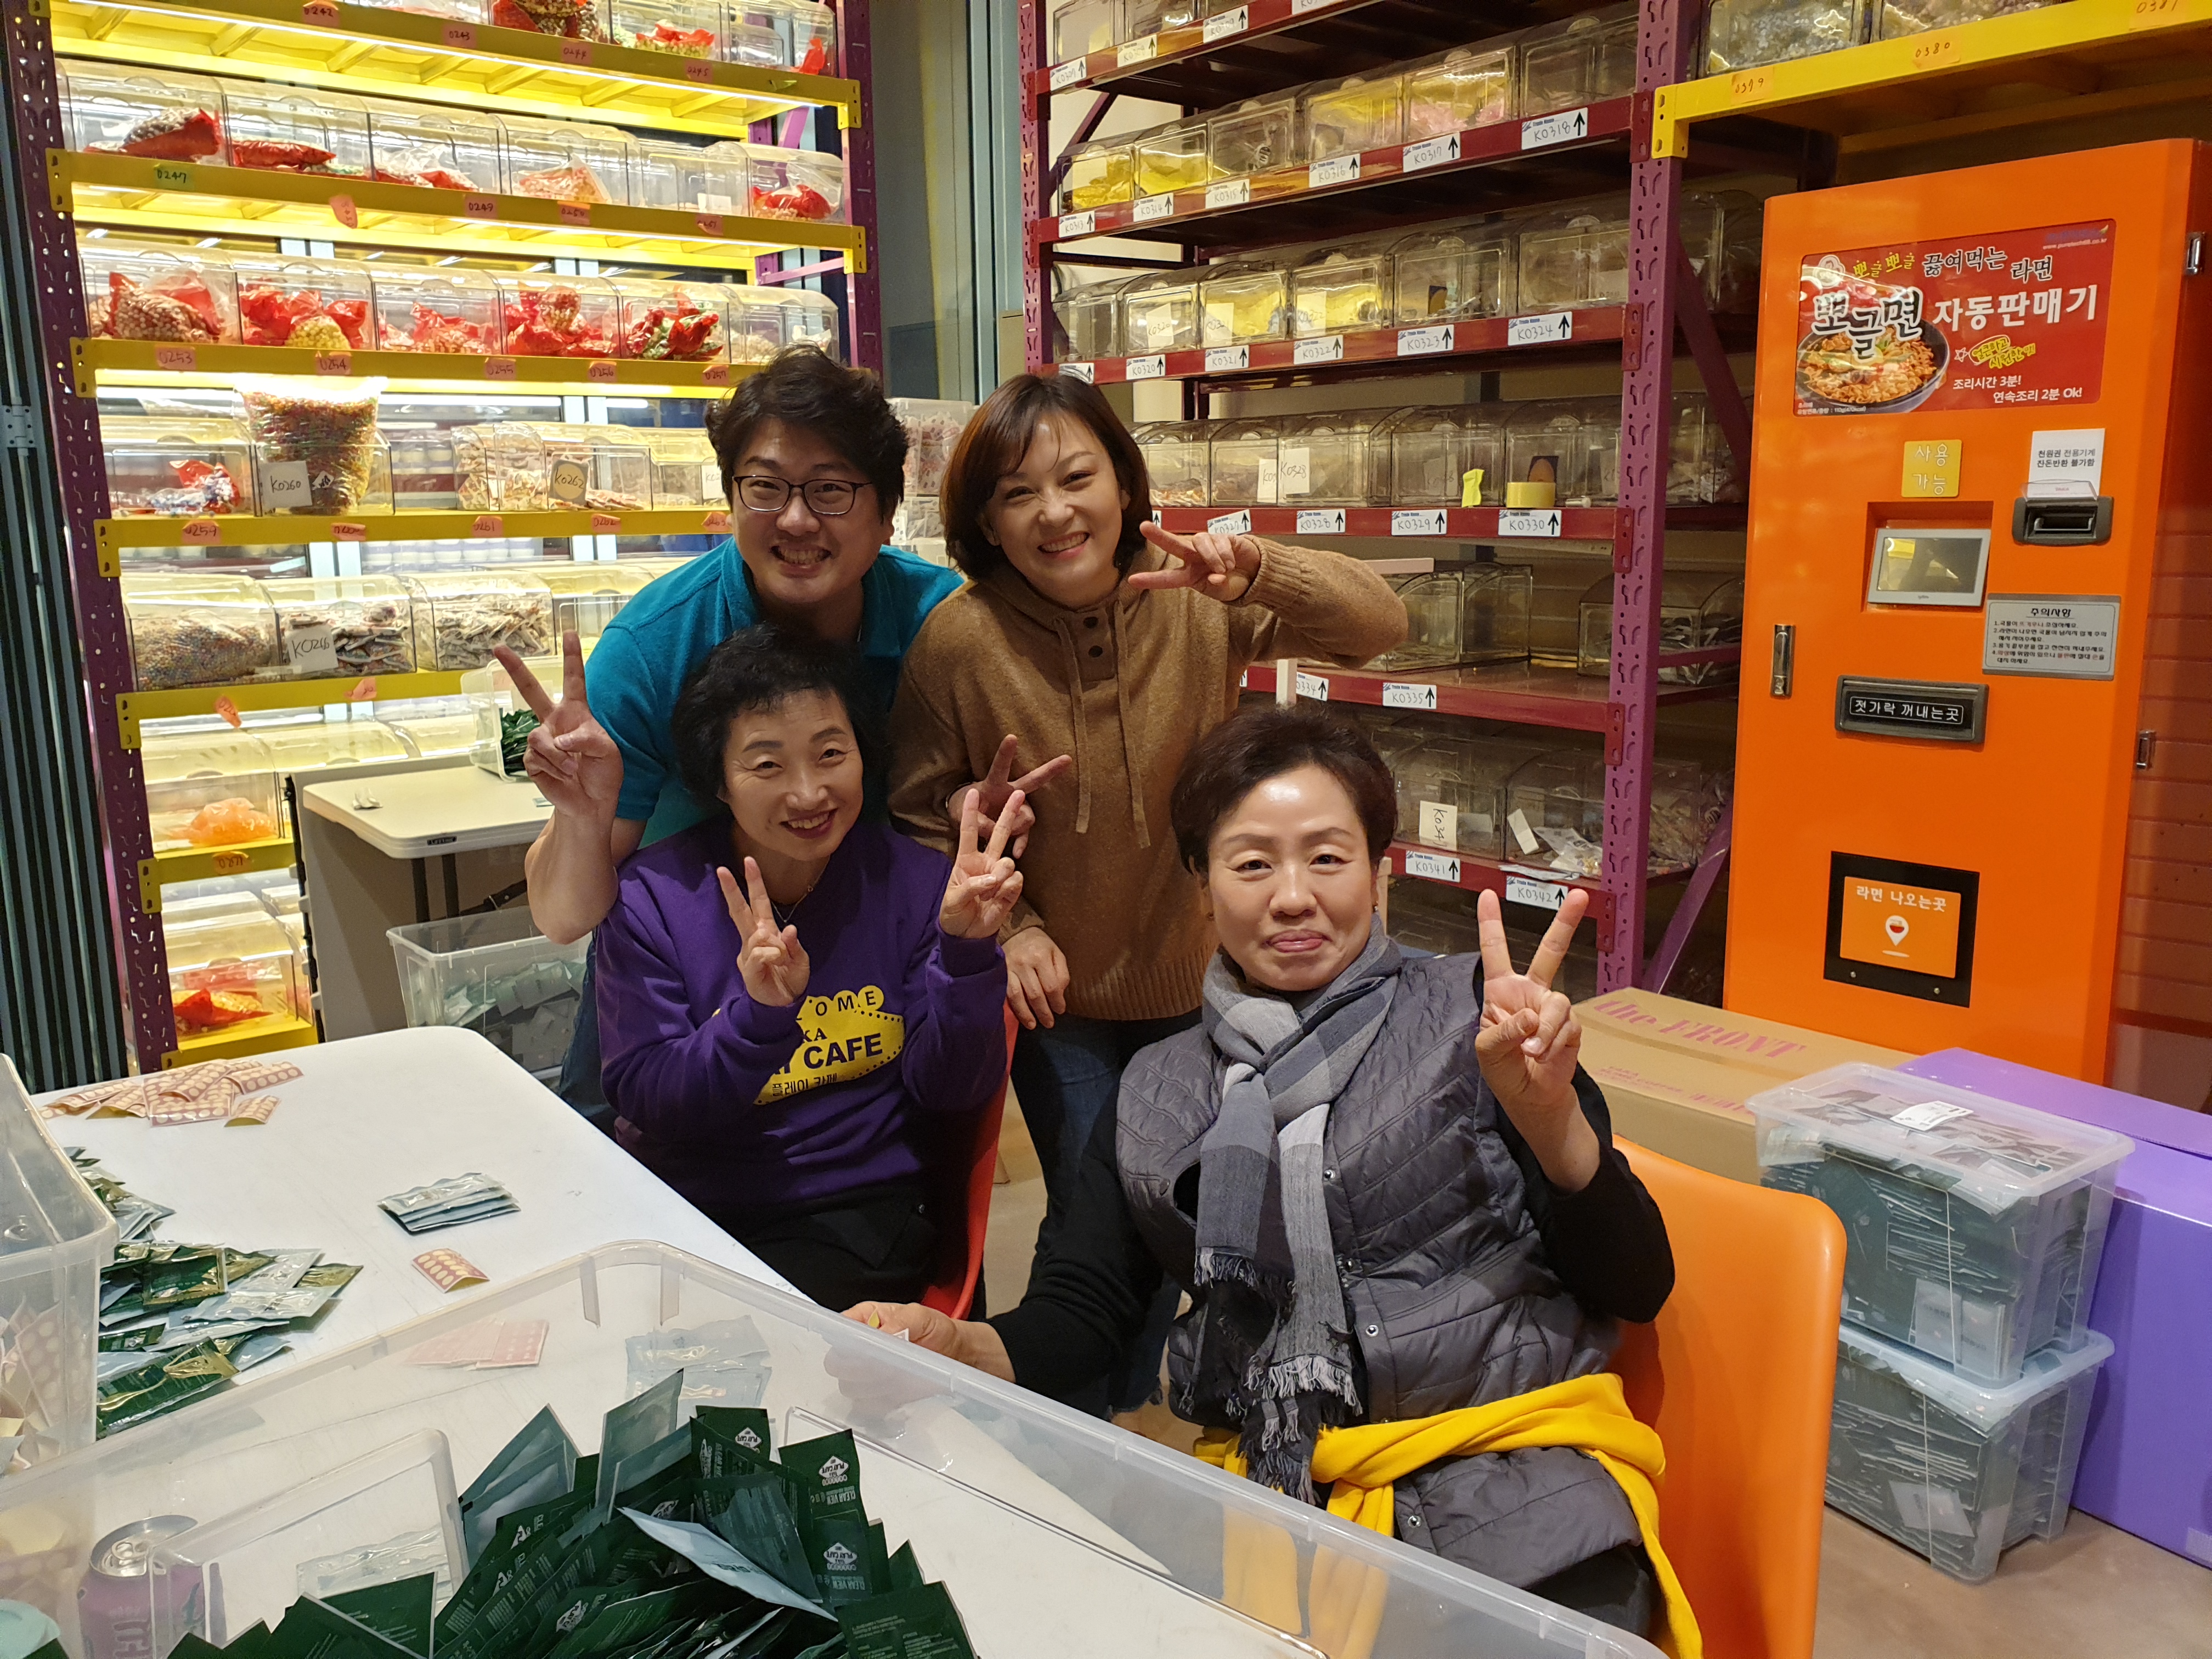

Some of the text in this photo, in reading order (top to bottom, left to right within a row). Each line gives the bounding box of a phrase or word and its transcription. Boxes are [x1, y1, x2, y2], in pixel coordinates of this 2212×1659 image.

[1915, 42, 1950, 58] 0380
[1533, 121, 1571, 142] K0318
[157, 168, 187, 184] 0247
[2010, 255, 2052, 284] 라면
[1933, 285, 2098, 331] 자동판매기
[1517, 324, 1553, 340] K0324
[1408, 336, 1440, 349] K0323
[1213, 353, 1237, 366] K0321
[1303, 346, 1331, 359] K0322
[1132, 364, 1156, 376] K0320
[1953, 375, 2021, 390] 조리시간 3분!
[1993, 387, 2083, 403] 연속조리 2분 Ok!
[1914, 443, 1949, 466] 사용
[270, 475, 302, 494] K0260
[553, 467, 584, 490] K0262
[1912, 473, 1948, 495] 가능
[1301, 518, 1331, 531] K0328
[1397, 518, 1430, 531] K0329
[1509, 519, 1545, 532] K0330
[1296, 680, 1317, 696] 0334
[1392, 692, 1423, 704] K0335
[1855, 699, 1959, 722] 젓가락 꺼내는곳
[1415, 859, 1445, 875] K0341
[1517, 887, 1553, 902] K0342
[1857, 885, 1946, 912] 라면 나오는곳
[803, 1033, 883, 1069] CAFE
[772, 1079, 810, 1098] 플레이
